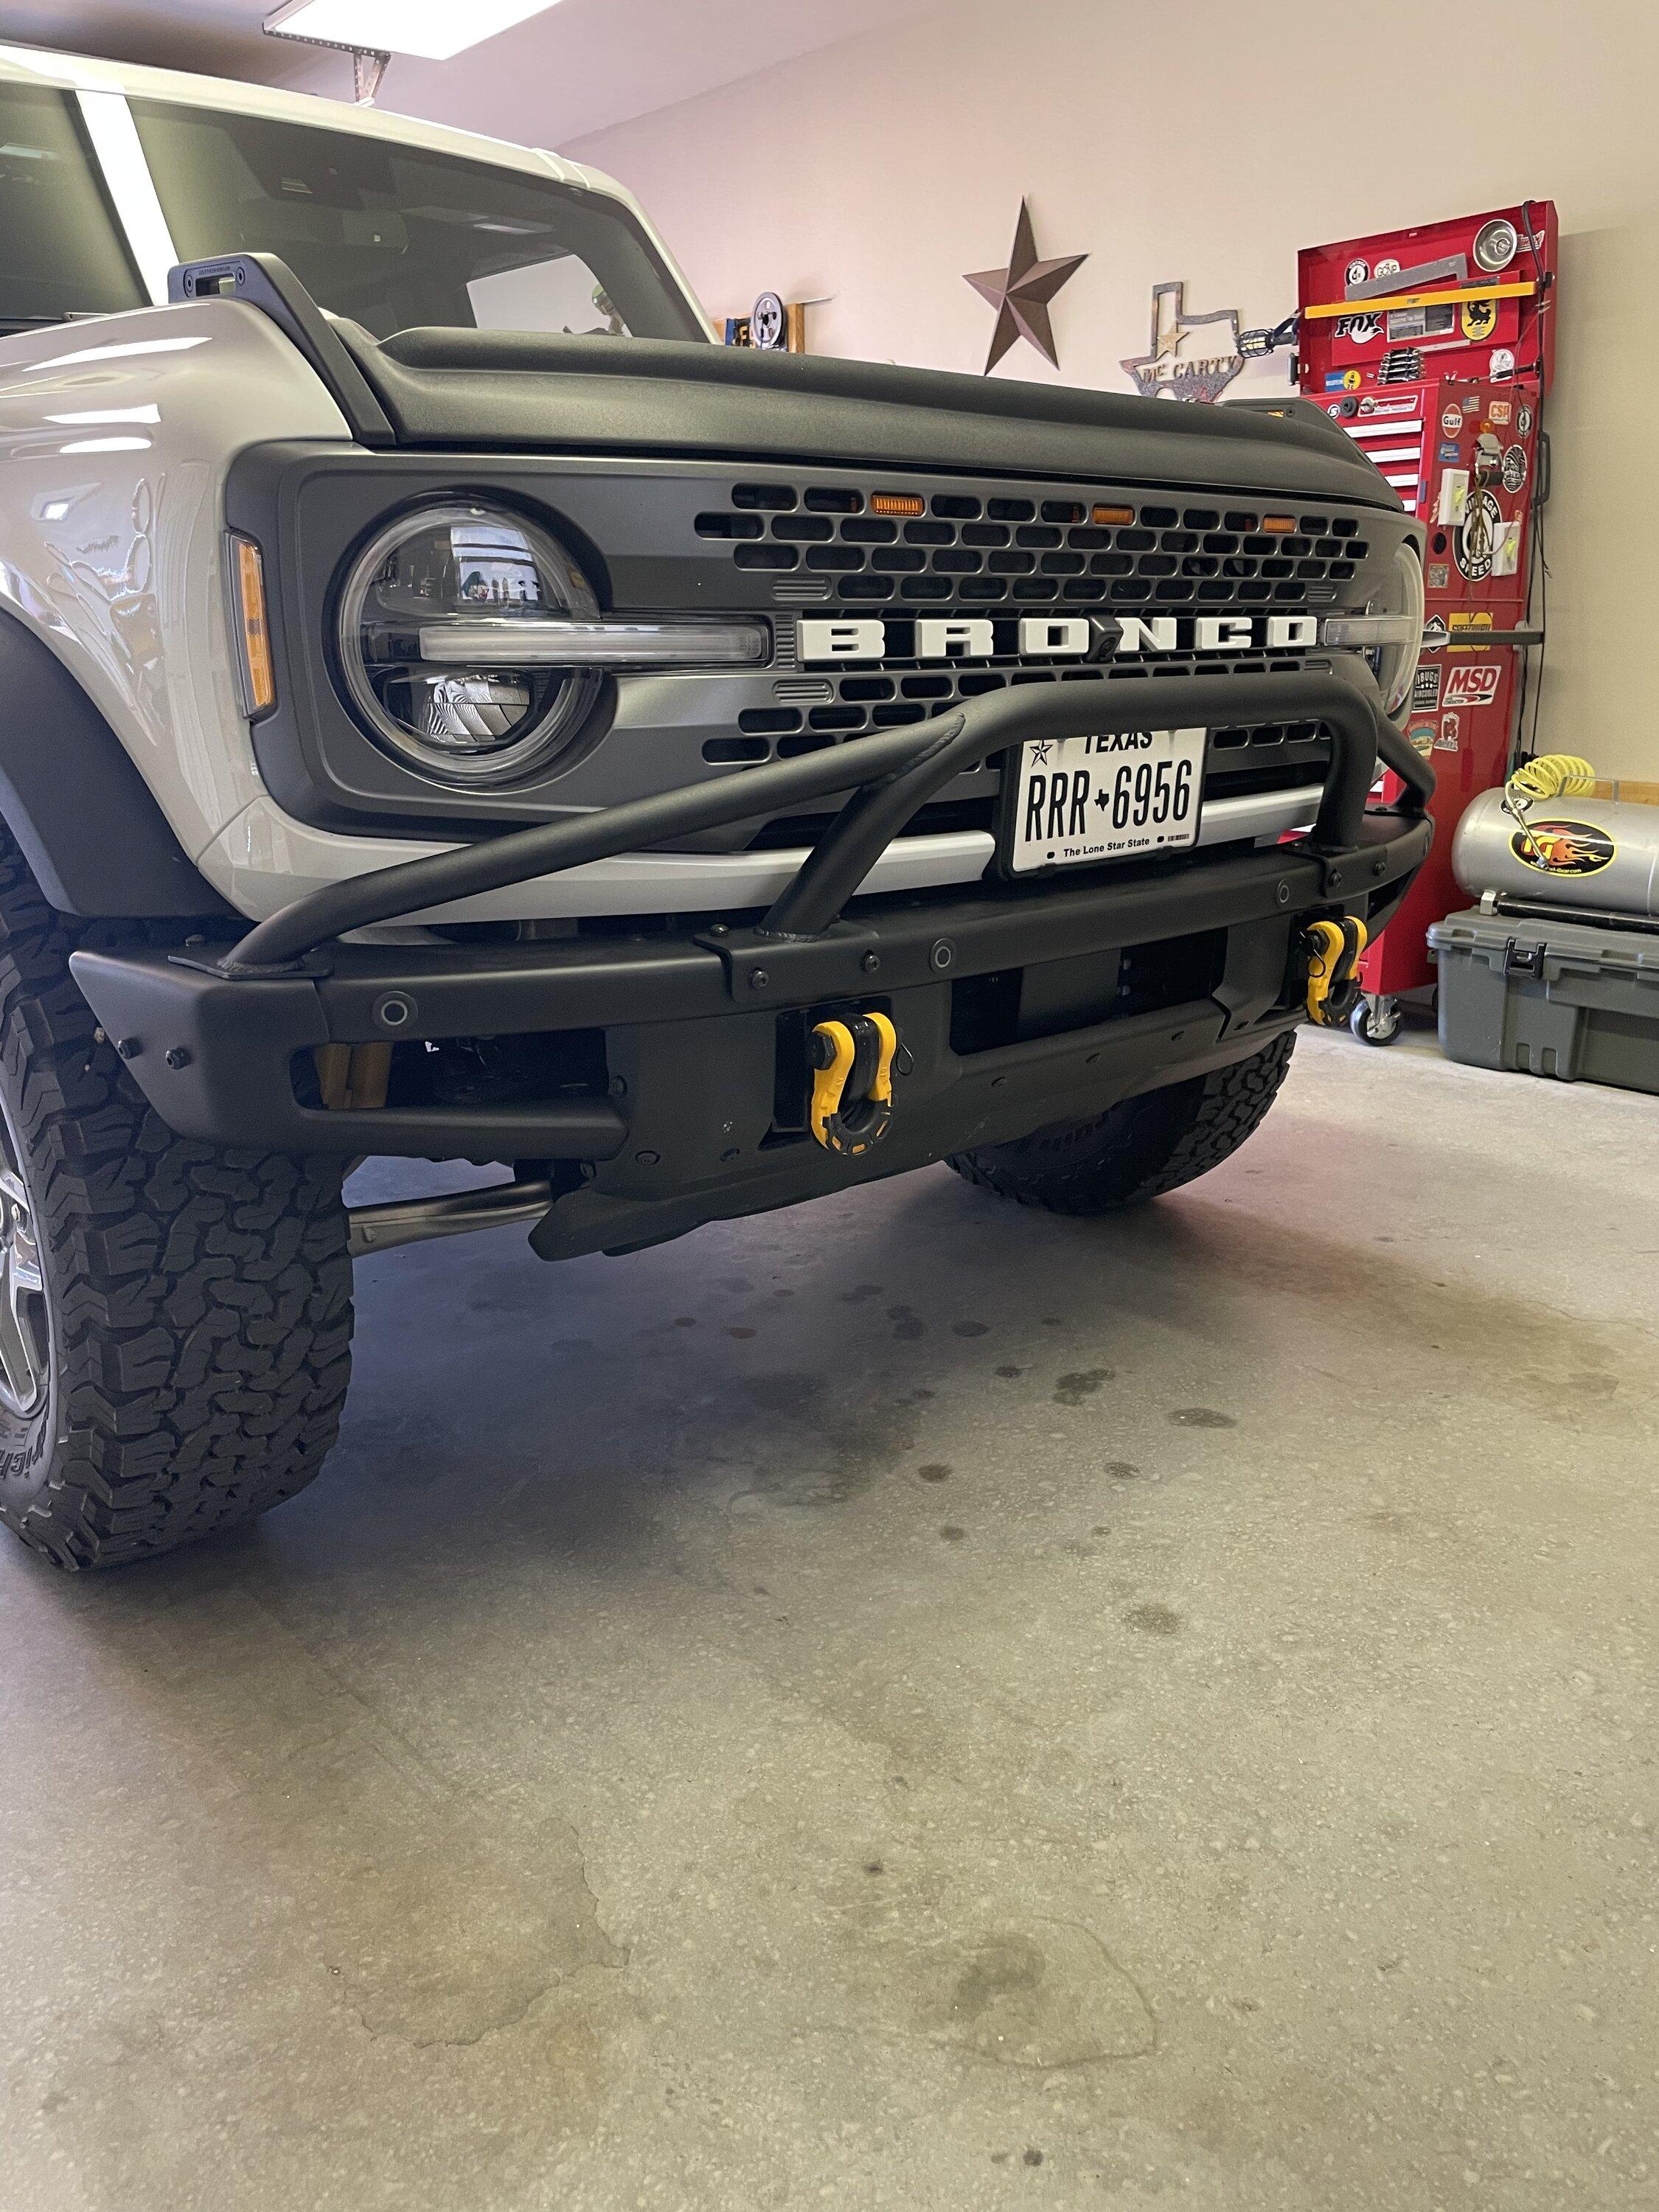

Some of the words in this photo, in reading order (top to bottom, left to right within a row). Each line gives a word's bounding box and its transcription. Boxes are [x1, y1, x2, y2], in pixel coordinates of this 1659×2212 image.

[1335, 313, 1382, 337] FOX
[1443, 416, 1461, 426] Gulf
[1465, 495, 1498, 518] VINAGE
[796, 616, 1317, 662] BRONCO
[1449, 669, 1497, 693] MSD
[1085, 731, 1152, 754] TEXAS
[1063, 848, 1081, 858] The
[1083, 844, 1105, 855] Lone
[1107, 841, 1125, 851] Star
[1127, 837, 1150, 848] State
